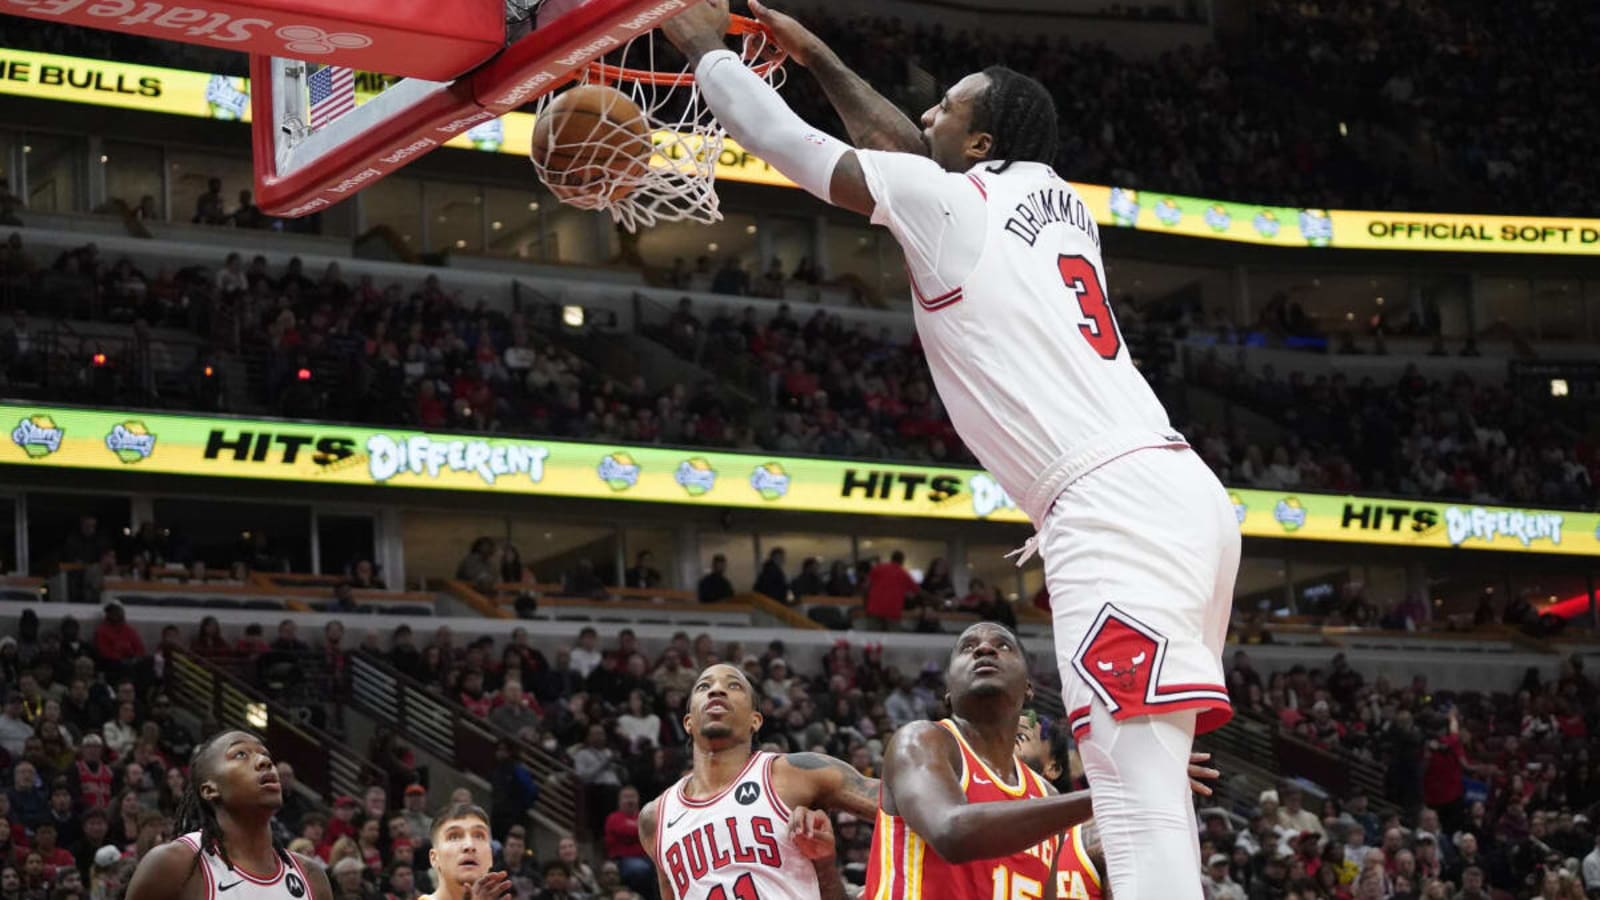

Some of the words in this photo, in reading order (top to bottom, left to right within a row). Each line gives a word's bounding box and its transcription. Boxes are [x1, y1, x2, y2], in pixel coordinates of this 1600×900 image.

[554, 35, 620, 66] betway
[0, 60, 32, 82] E
[39, 65, 162, 97] BULLS
[496, 71, 557, 105] betway
[1368, 221, 1493, 241] OFFICIAL
[1500, 224, 1574, 243] SOFT
[1057, 253, 1121, 361] 3
[203, 429, 356, 466] HITS
[841, 469, 962, 503] HITS
[1341, 503, 1439, 533] HITS
[665, 816, 782, 900] BULLS
